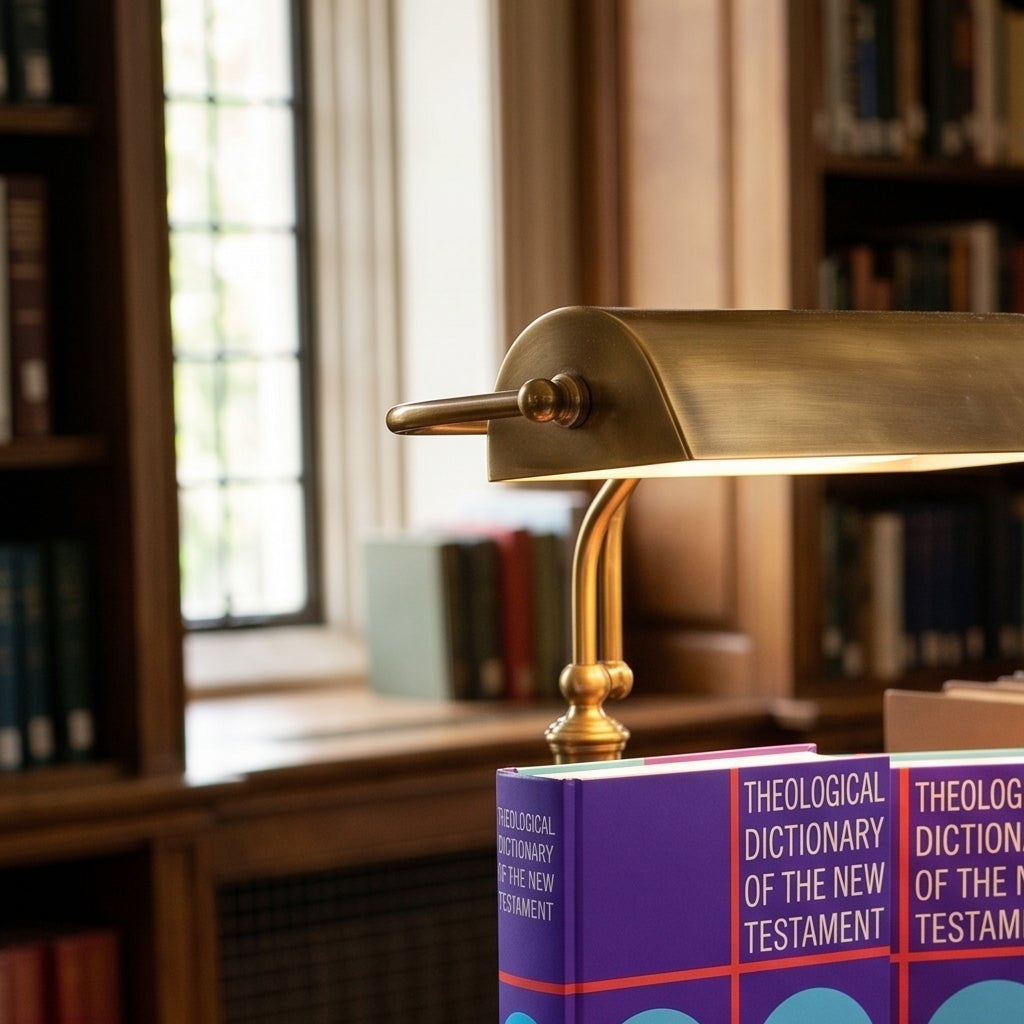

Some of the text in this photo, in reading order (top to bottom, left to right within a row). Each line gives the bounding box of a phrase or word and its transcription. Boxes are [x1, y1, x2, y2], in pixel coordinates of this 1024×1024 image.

[744, 771, 885, 814] THEOLOGICAL
[498, 806, 556, 836] THEOLOGICAL
[745, 815, 885, 861] DICTIONARY
[498, 834, 554, 864] DICTIONARY
[497, 862, 555, 893] OF THE NEW
[744, 861, 885, 908] OF THE NEW
[915, 868, 949, 902] OF
[956, 866, 1007, 899] THE
[498, 890, 554, 921] TESTAMENT
[744, 907, 885, 954] TESTAMENT
